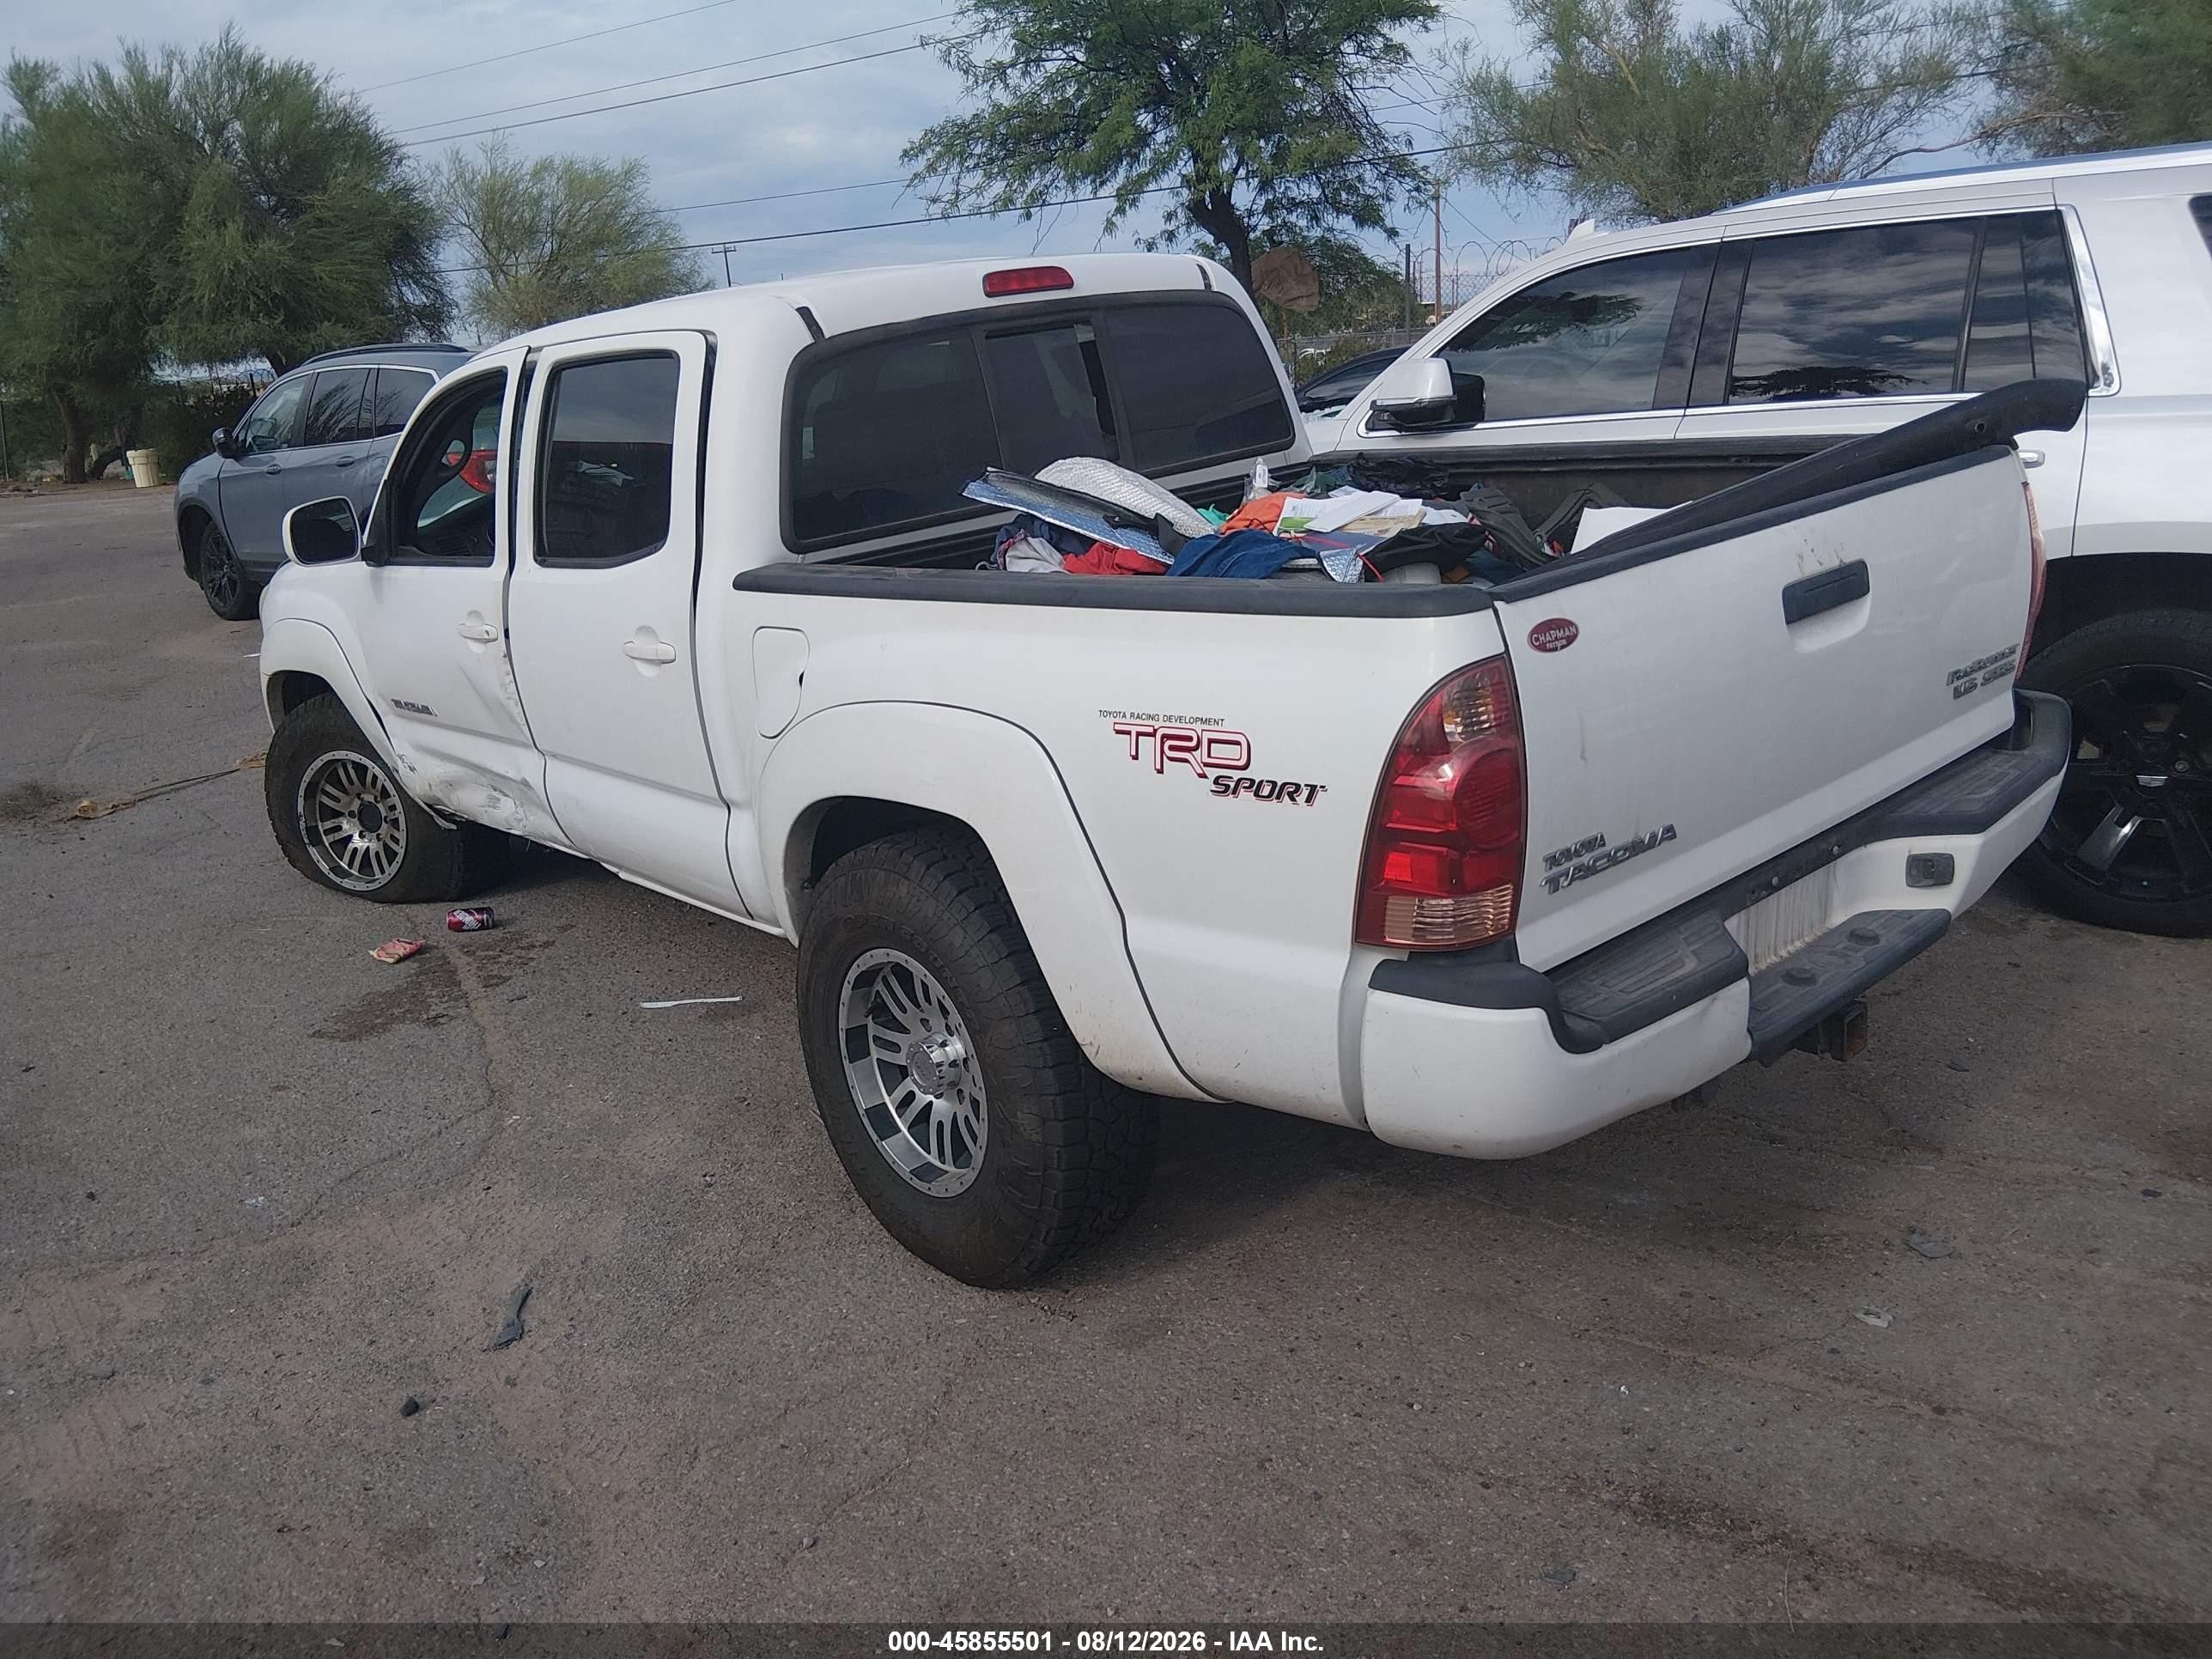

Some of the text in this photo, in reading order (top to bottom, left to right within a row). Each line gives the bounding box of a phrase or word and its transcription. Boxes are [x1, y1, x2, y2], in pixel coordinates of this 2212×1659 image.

[1532, 624, 1577, 646] CHAPMAN
[1098, 709, 1225, 728] TOYOTA RACING DEVELOPMENT
[1113, 721, 1251, 780] TRD
[1210, 775, 1326, 807] SPORT
[1539, 823, 1677, 895] TACOMA
[1542, 831, 1607, 872] TOYOTA
